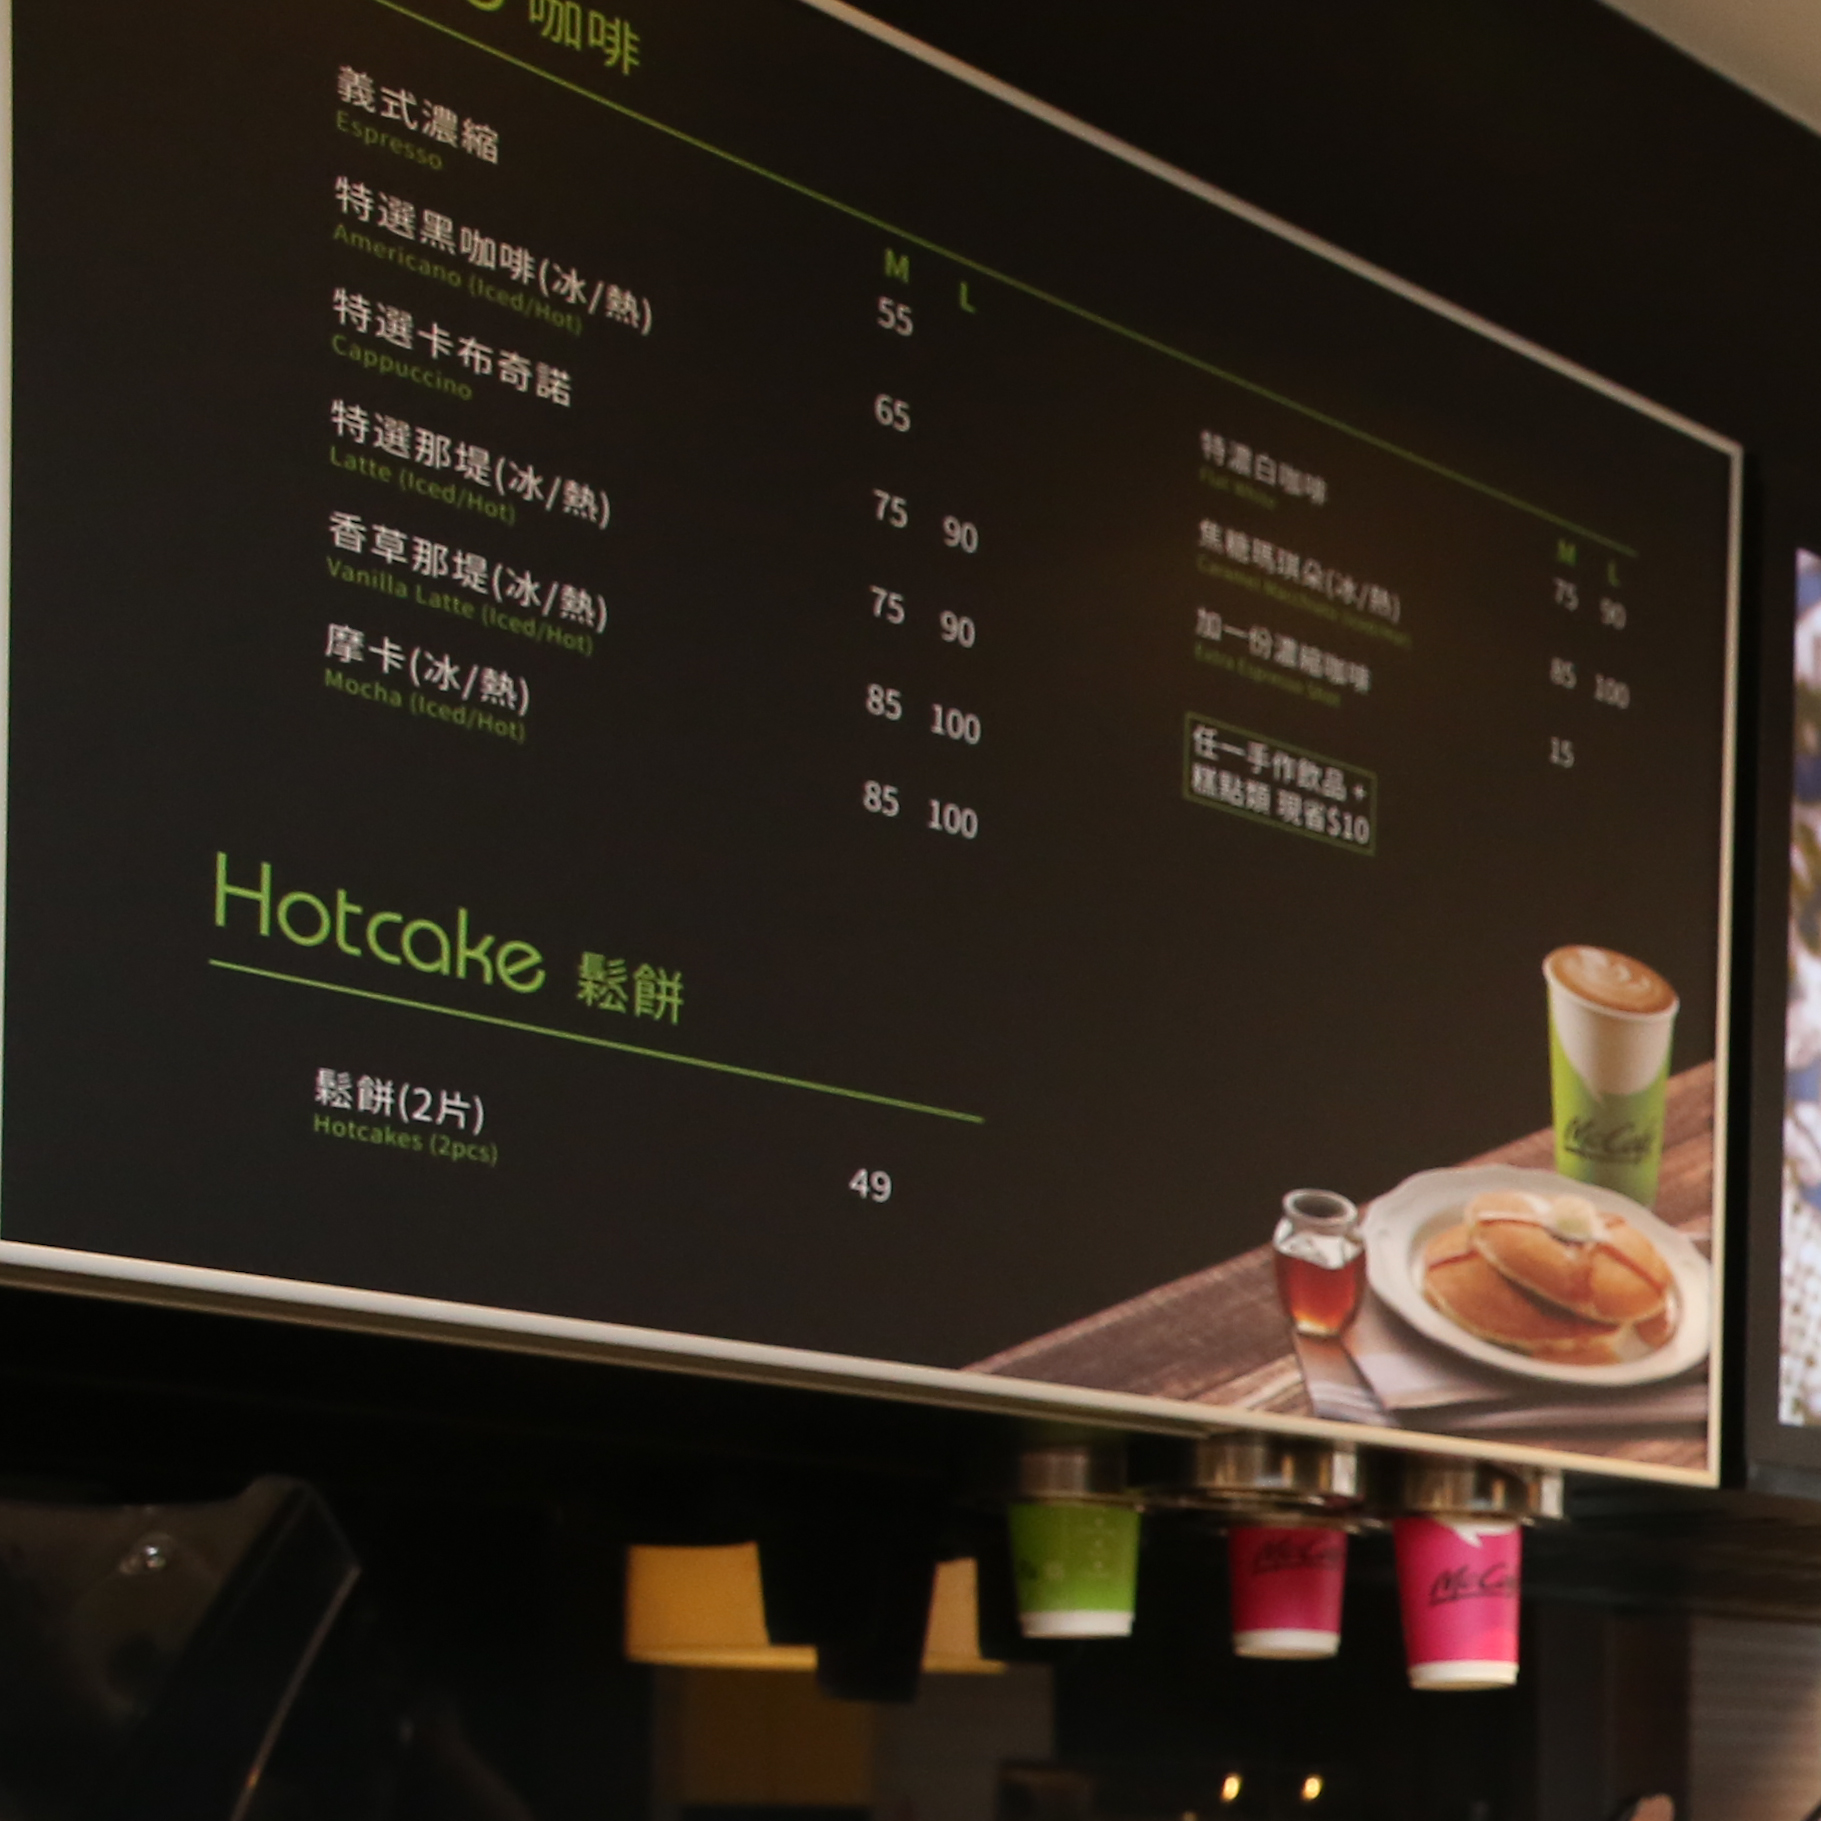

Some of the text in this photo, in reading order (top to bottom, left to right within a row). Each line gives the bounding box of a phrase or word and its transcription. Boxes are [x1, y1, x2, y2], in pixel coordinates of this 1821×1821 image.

[528, 0, 640, 76] 咖啡
[335, 110, 443, 170] Espresso
[336, 65, 499, 165] 義式濃縮
[332, 223, 583, 337] Americano (Iced/Hot)
[884, 248, 975, 314] M L
[332, 287, 571, 407] 特選卡布奇諾
[876, 296, 914, 337] 55
[331, 333, 474, 400] Cappuccino
[874, 393, 911, 432] 65
[330, 446, 516, 526] Latte (Iced/Hot)
[872, 487, 979, 553] 75 90
[325, 555, 594, 657] Vanilla Latte (Iced/Hot)
[868, 584, 976, 648] 75 90
[1553, 577, 1579, 612] 75
[325, 622, 530, 717] 摩卡(冰/熱)
[324, 668, 527, 744] Mocha (Iced/Hot)
[866, 683, 981, 745] 85 100
[1550, 736, 1575, 768] 15
[863, 780, 978, 839] 85 100
[214, 851, 684, 1025] Hotcake 鬆餅
[314, 1066, 485, 1136] 鬆餅(2片)
[313, 1112, 499, 1168] Hotcakes (2pcs)
[848, 1168, 893, 1204] 49
